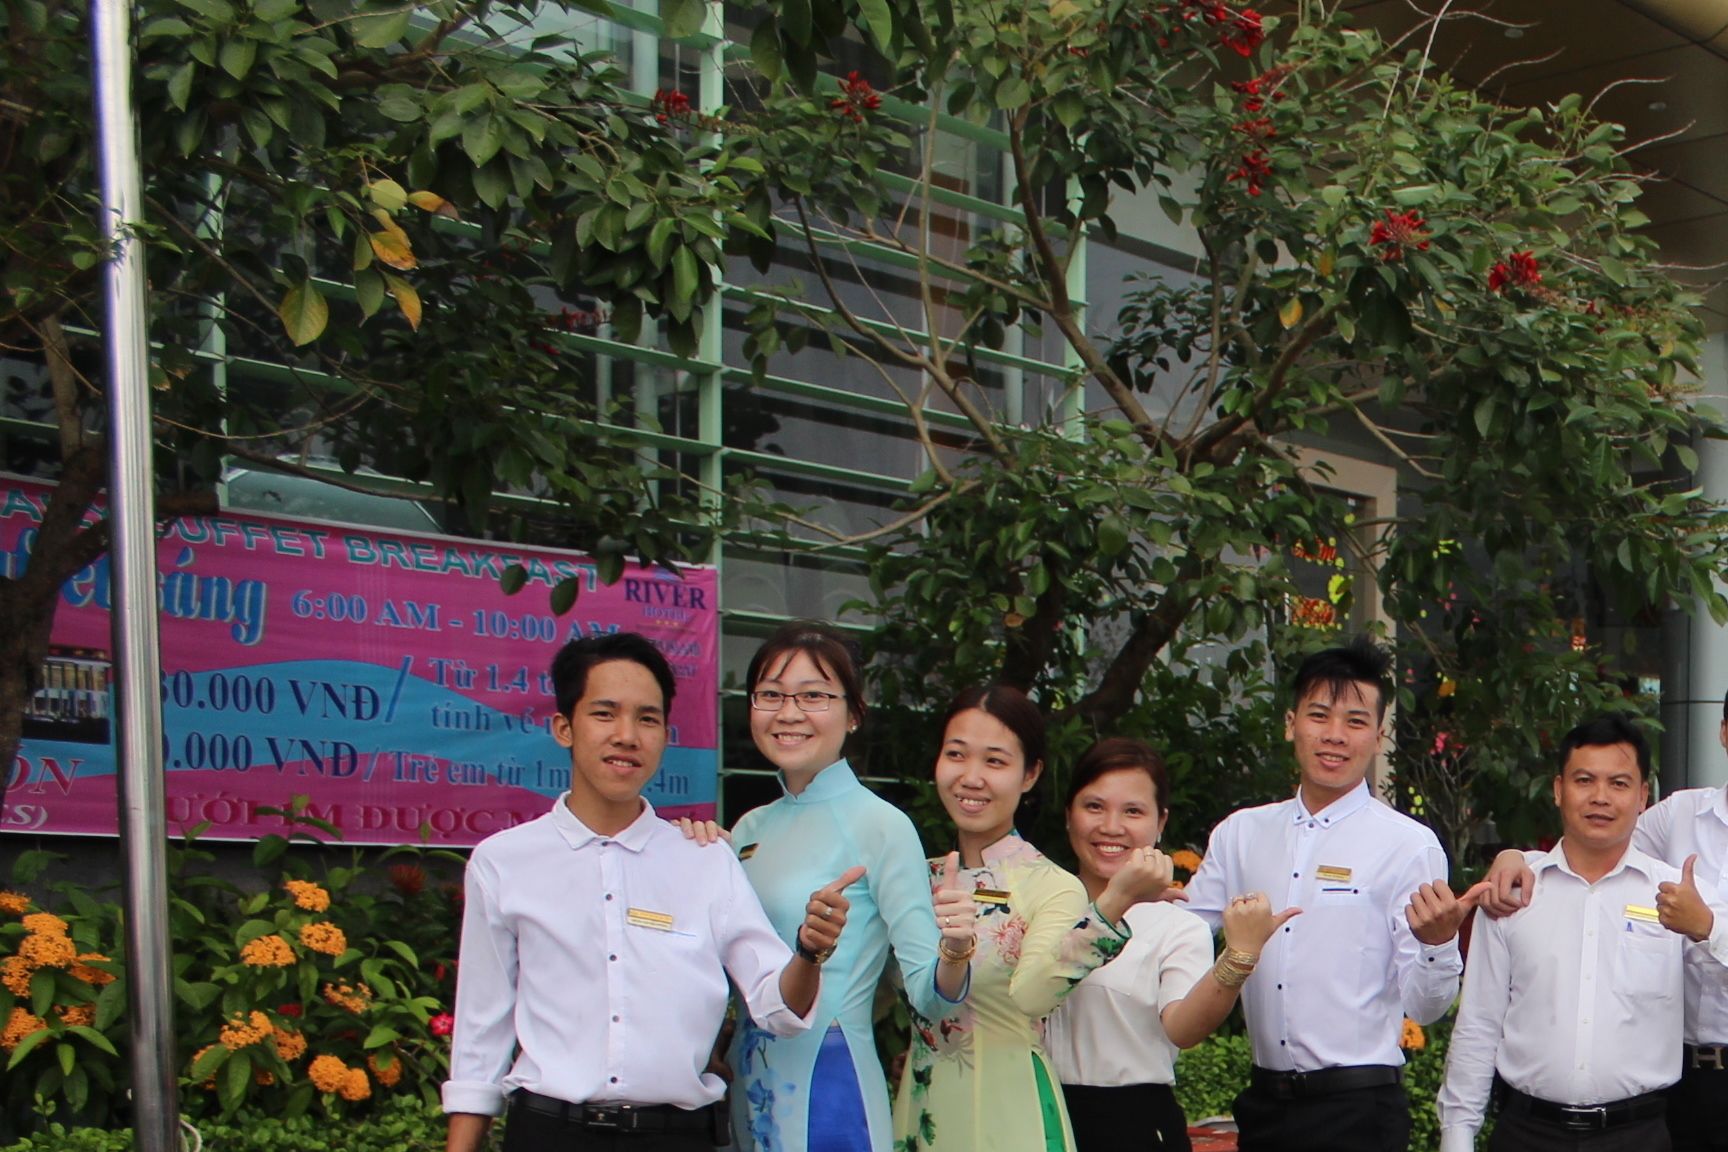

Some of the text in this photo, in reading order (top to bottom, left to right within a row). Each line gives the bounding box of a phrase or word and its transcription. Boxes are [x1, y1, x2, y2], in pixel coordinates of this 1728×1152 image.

[156, 515, 329, 559] UFFET
[157, 544, 268, 646] áng
[291, 588, 368, 624] 6:00
[374, 598, 442, 632] AM
[472, 608, 557, 643] 10:00
[624, 578, 707, 610] RIVER
[428, 657, 477, 691] Từ
[486, 661, 529, 693] 1.4
[445, 762, 488, 786] em
[496, 761, 525, 788] từ
[646, 767, 691, 796] .4m
[165, 790, 257, 827] ƯỚI
[360, 800, 491, 838] ĐƯỢC
